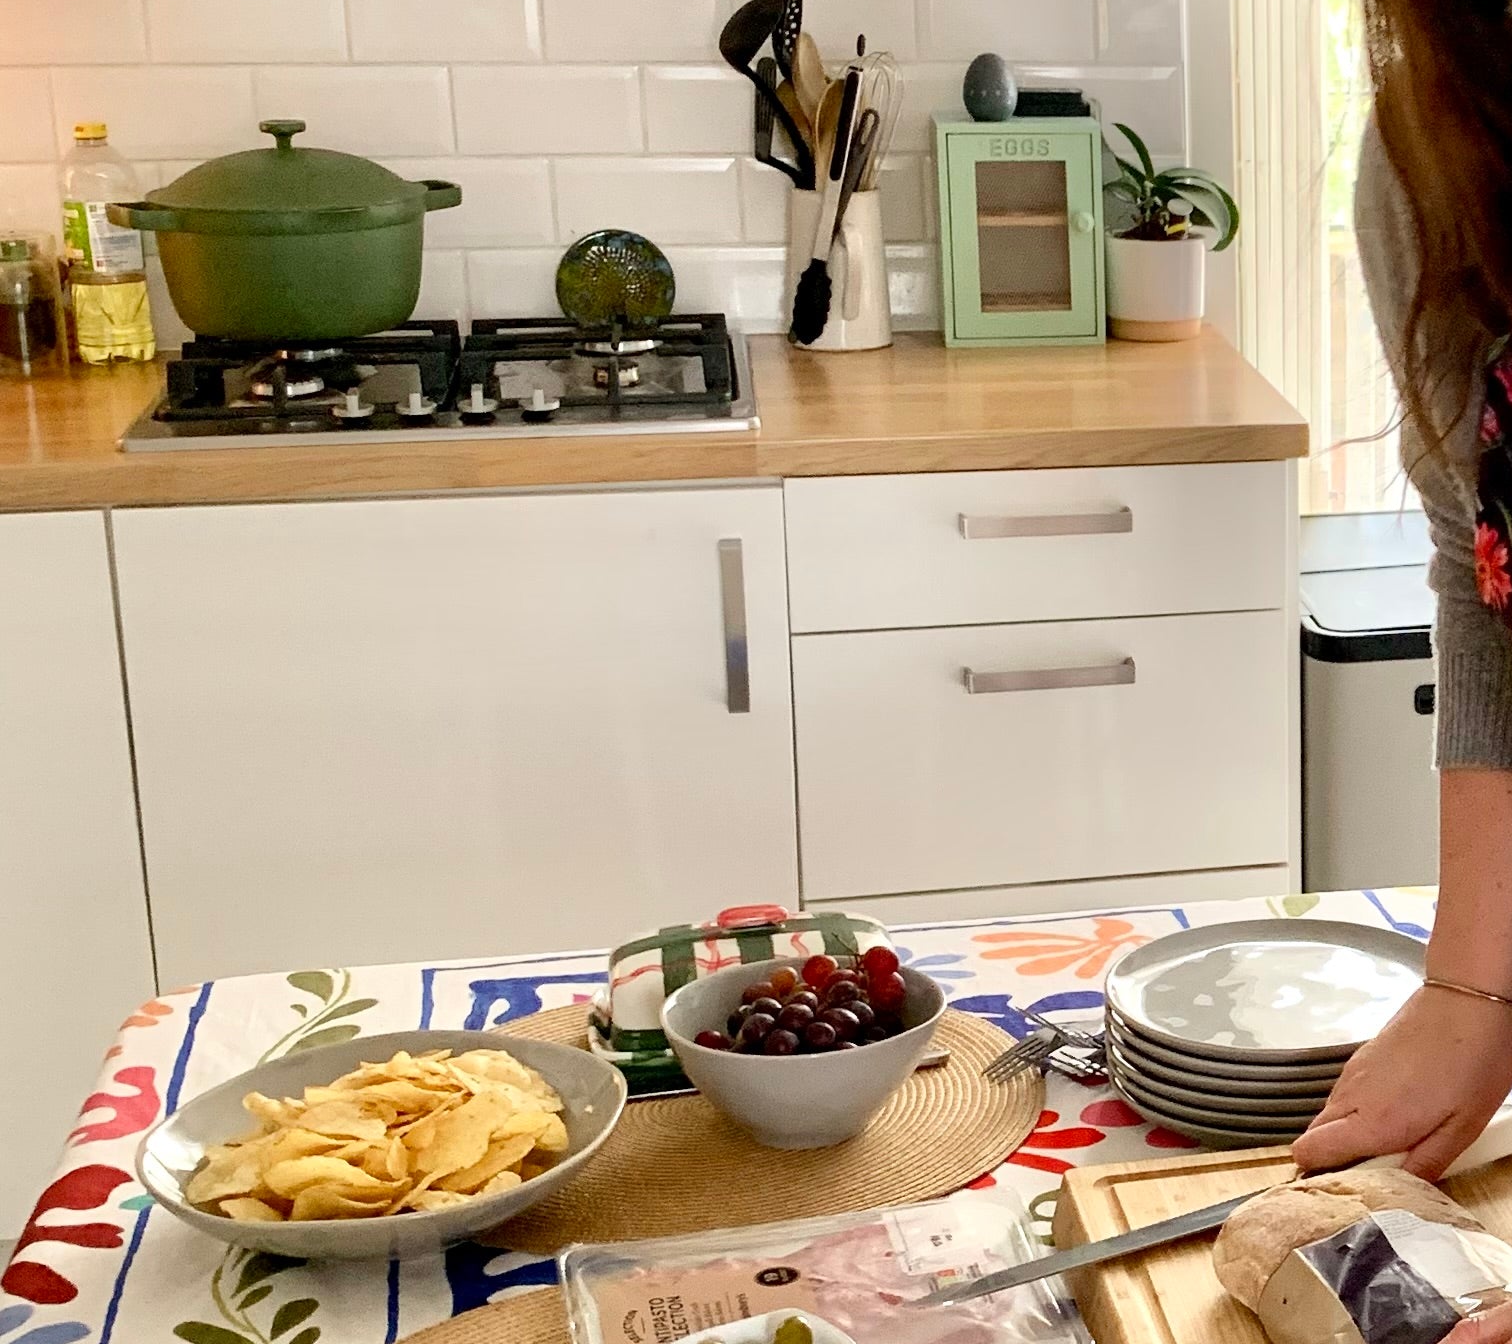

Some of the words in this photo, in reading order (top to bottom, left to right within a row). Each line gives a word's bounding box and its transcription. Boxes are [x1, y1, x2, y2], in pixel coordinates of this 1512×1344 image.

[990, 138, 1050, 157] EGGS
[623, 1309, 644, 1344] SELECTION
[666, 1295, 690, 1340] LECTION
